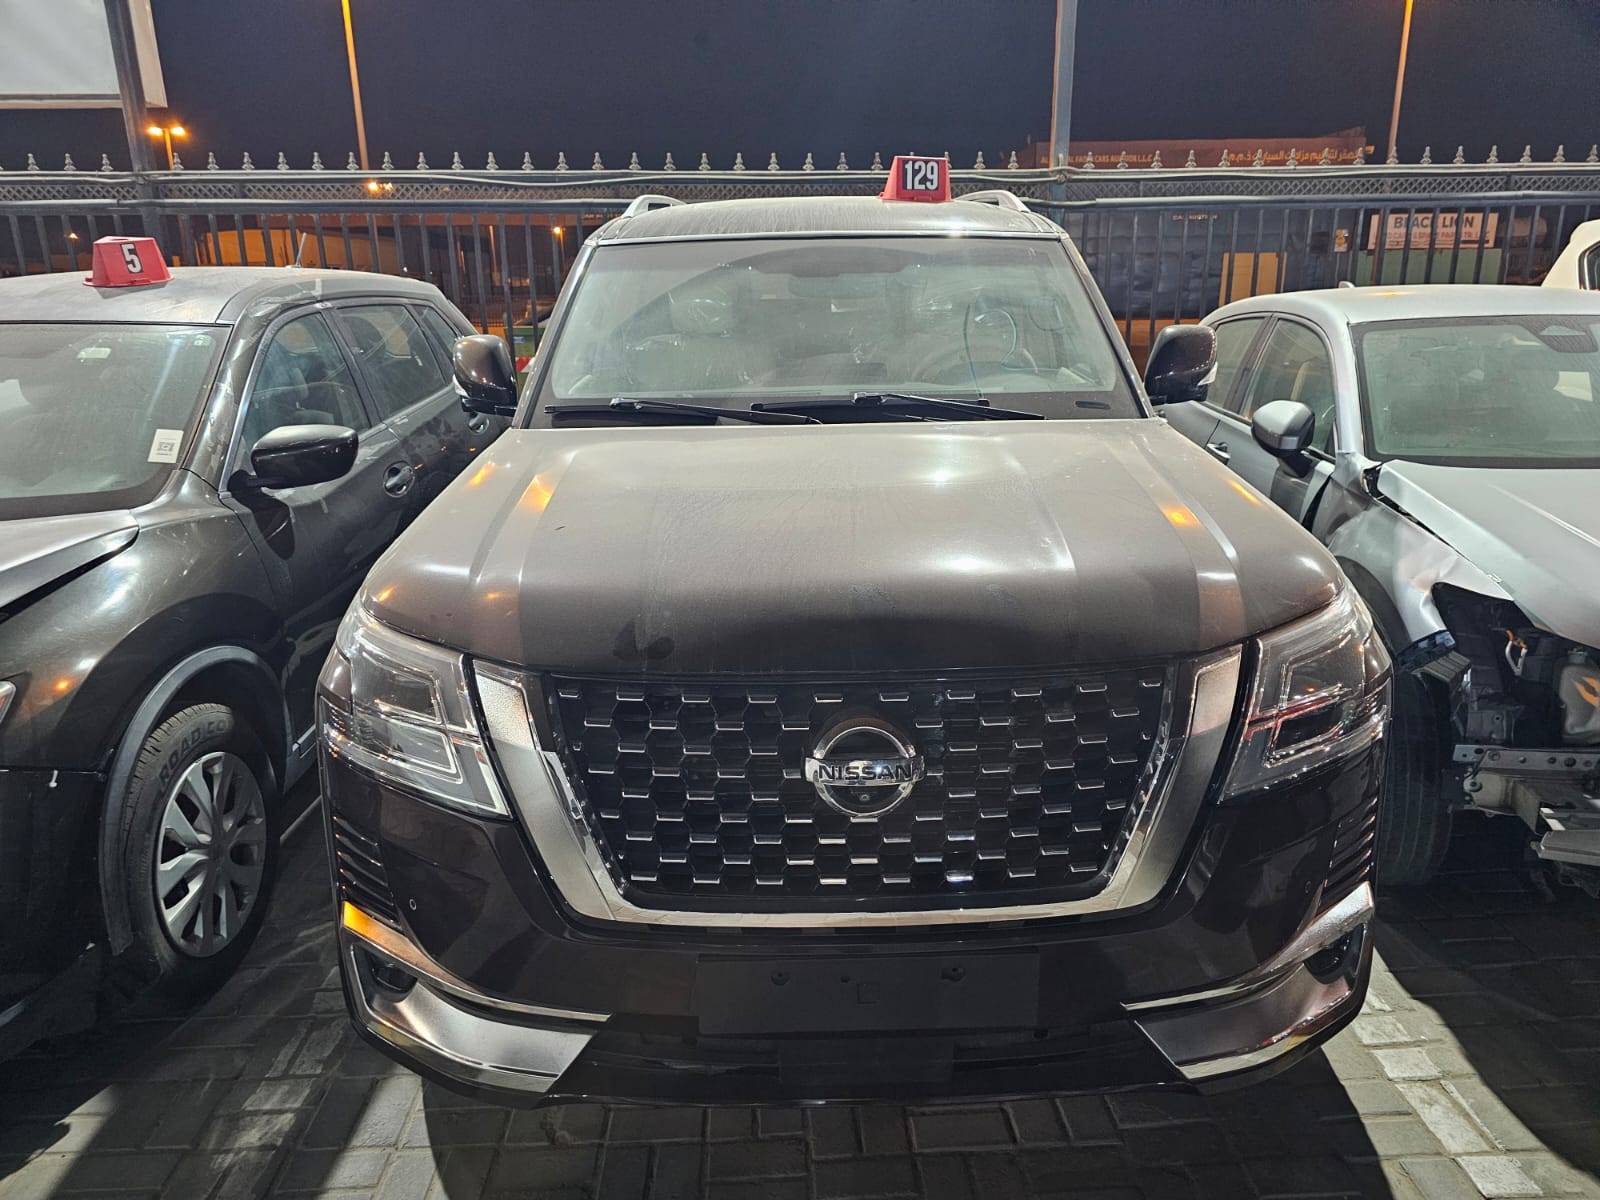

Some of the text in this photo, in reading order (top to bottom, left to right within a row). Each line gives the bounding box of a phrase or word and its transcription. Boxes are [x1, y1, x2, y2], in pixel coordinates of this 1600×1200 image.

[904, 160, 939, 190] 129
[1442, 215, 1475, 229] LIN
[121, 243, 142, 273] 5
[818, 763, 913, 781] NISSAN
